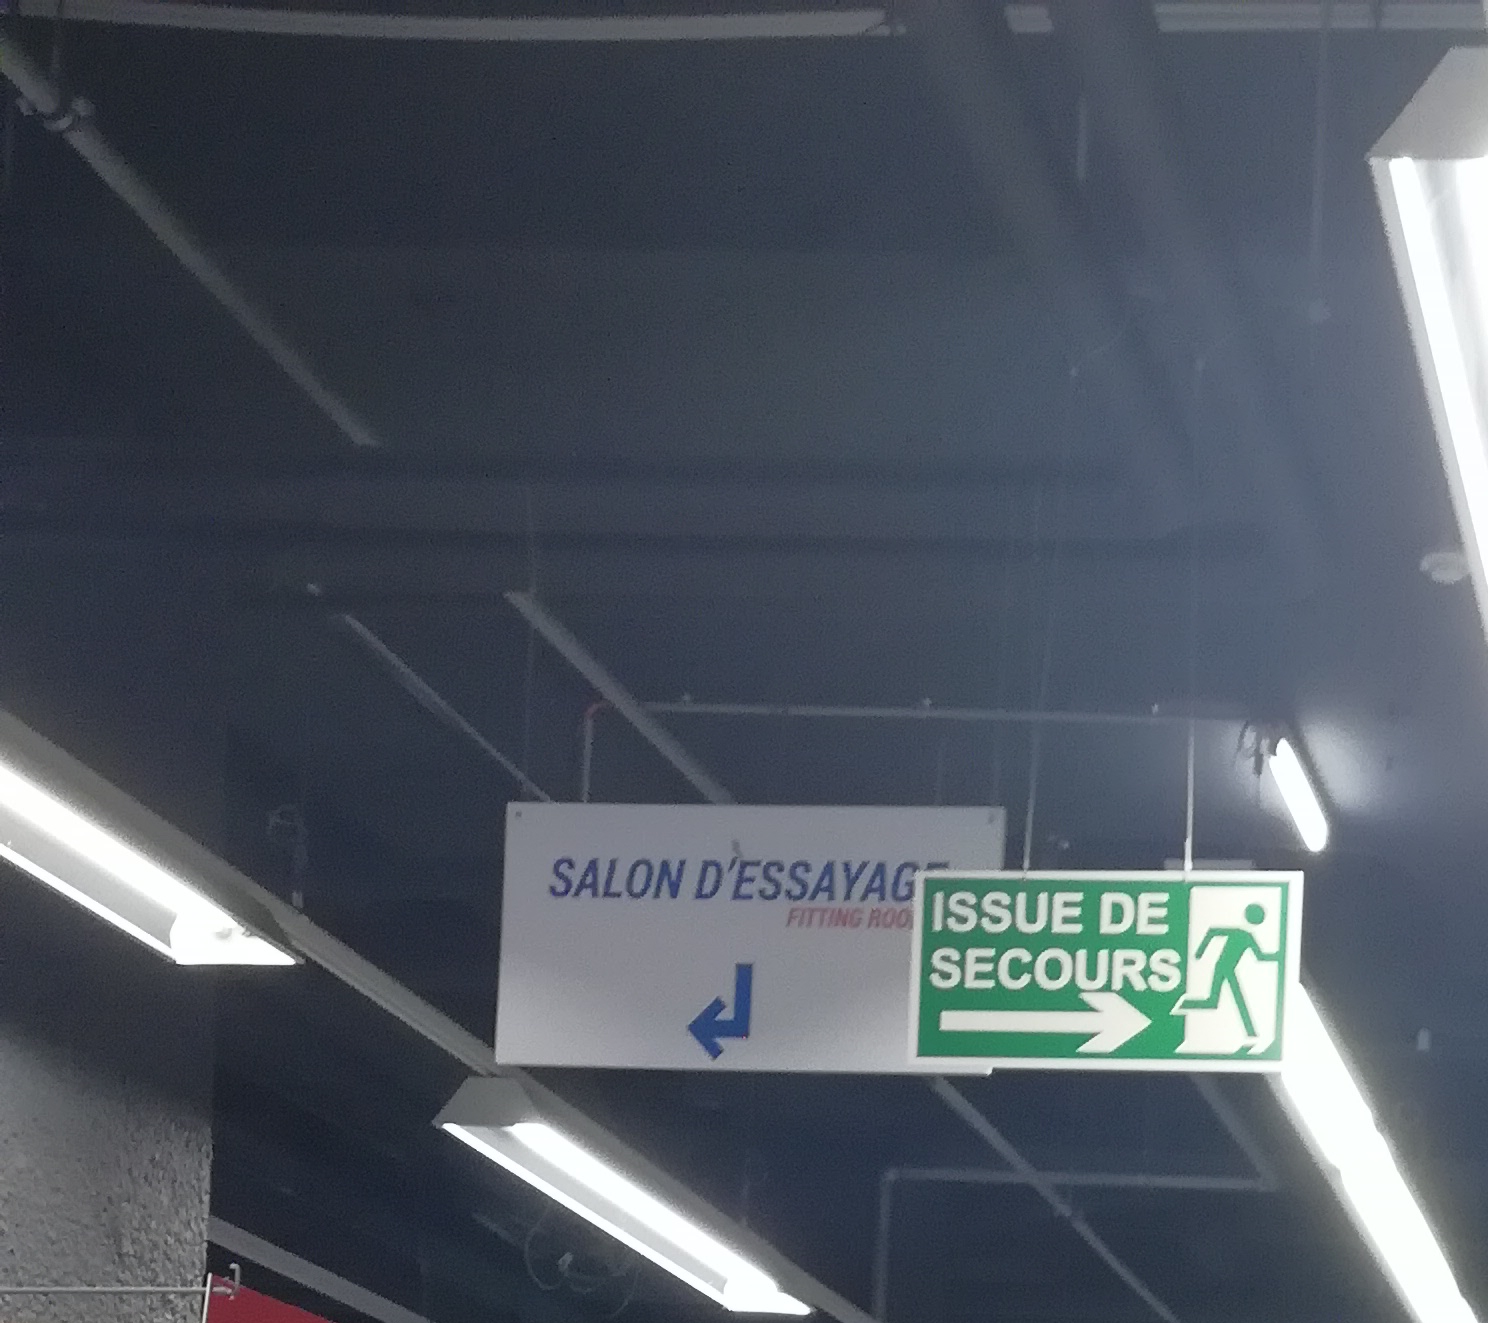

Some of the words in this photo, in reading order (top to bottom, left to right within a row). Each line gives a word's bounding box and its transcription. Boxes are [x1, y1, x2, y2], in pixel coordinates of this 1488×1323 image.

[548, 857, 686, 899] SALON
[695, 855, 950, 902] D'ESSAYAG
[786, 905, 864, 928] FITTING
[867, 906, 915, 929] ROO
[931, 891, 1084, 935] ISSUE
[1100, 891, 1171, 935] DE
[929, 948, 1182, 992] SECOURS
